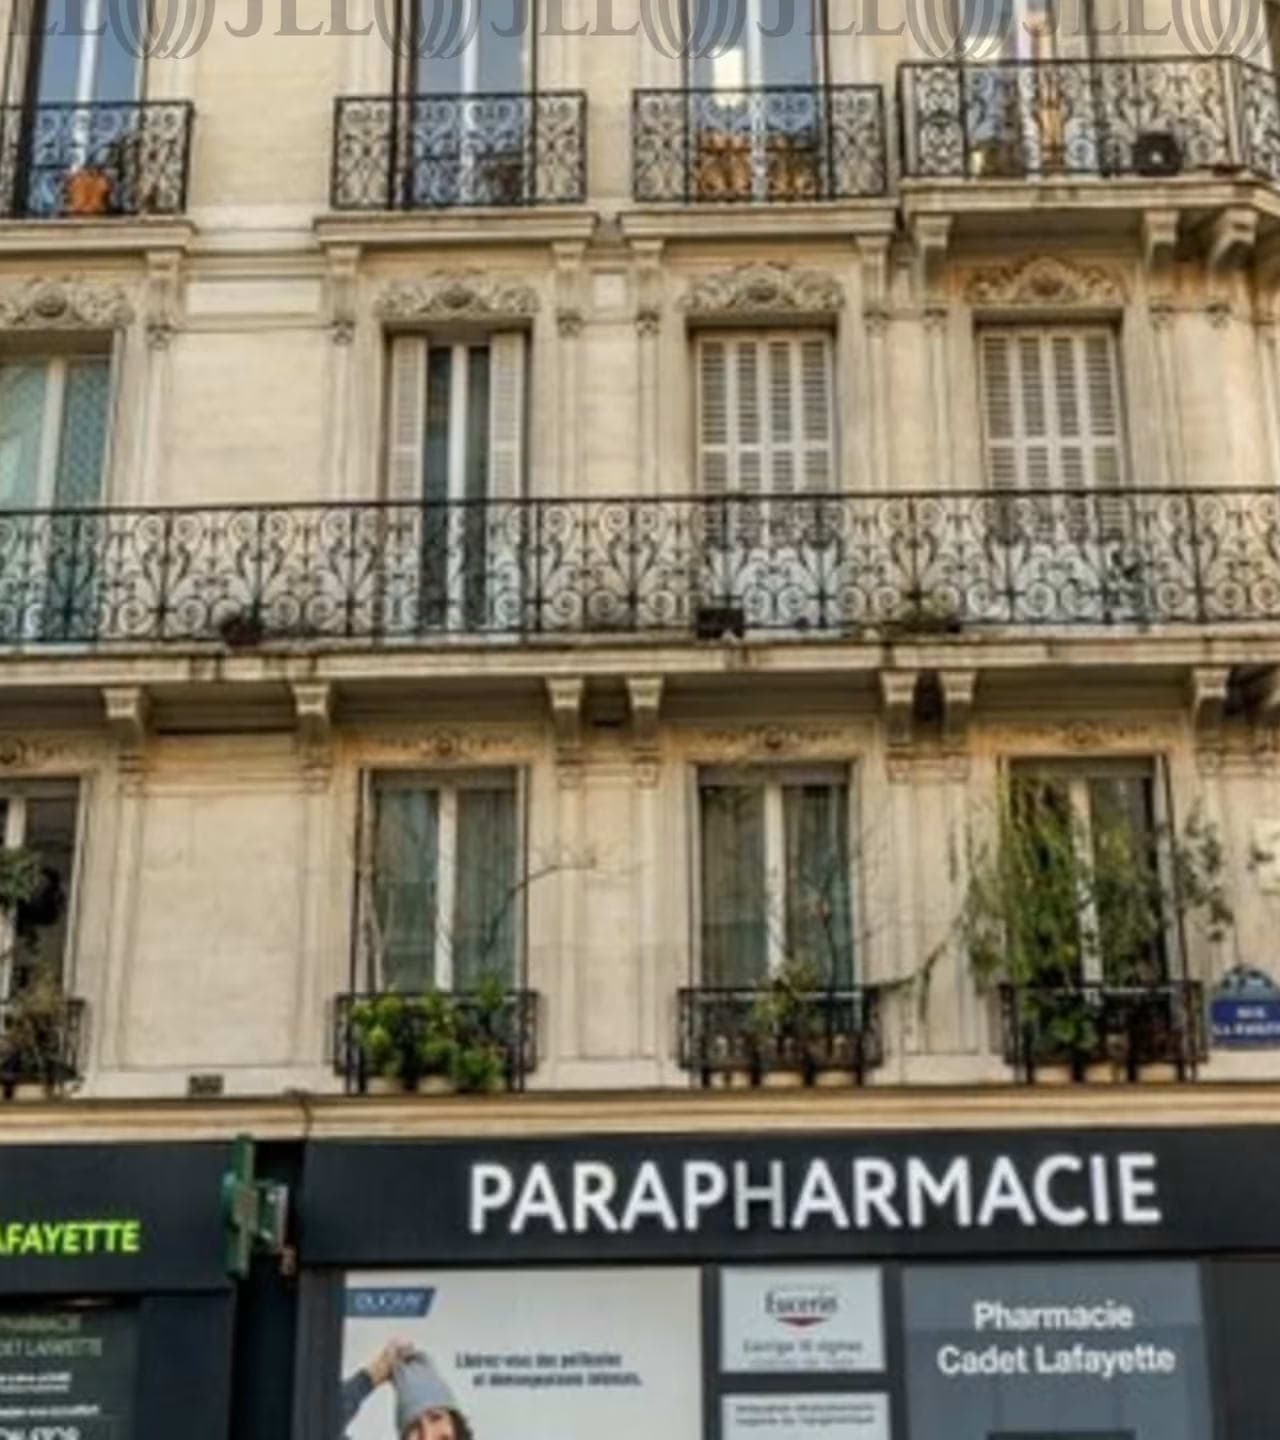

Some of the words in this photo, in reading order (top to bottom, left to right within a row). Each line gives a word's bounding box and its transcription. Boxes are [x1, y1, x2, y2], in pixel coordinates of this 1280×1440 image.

[468, 1151, 1162, 1234] PARAPHARMACIE
[973, 1298, 1134, 1330] Pharmacie
[936, 1344, 1029, 1376] Cadet
[1035, 1343, 1177, 1381] Lafayette
